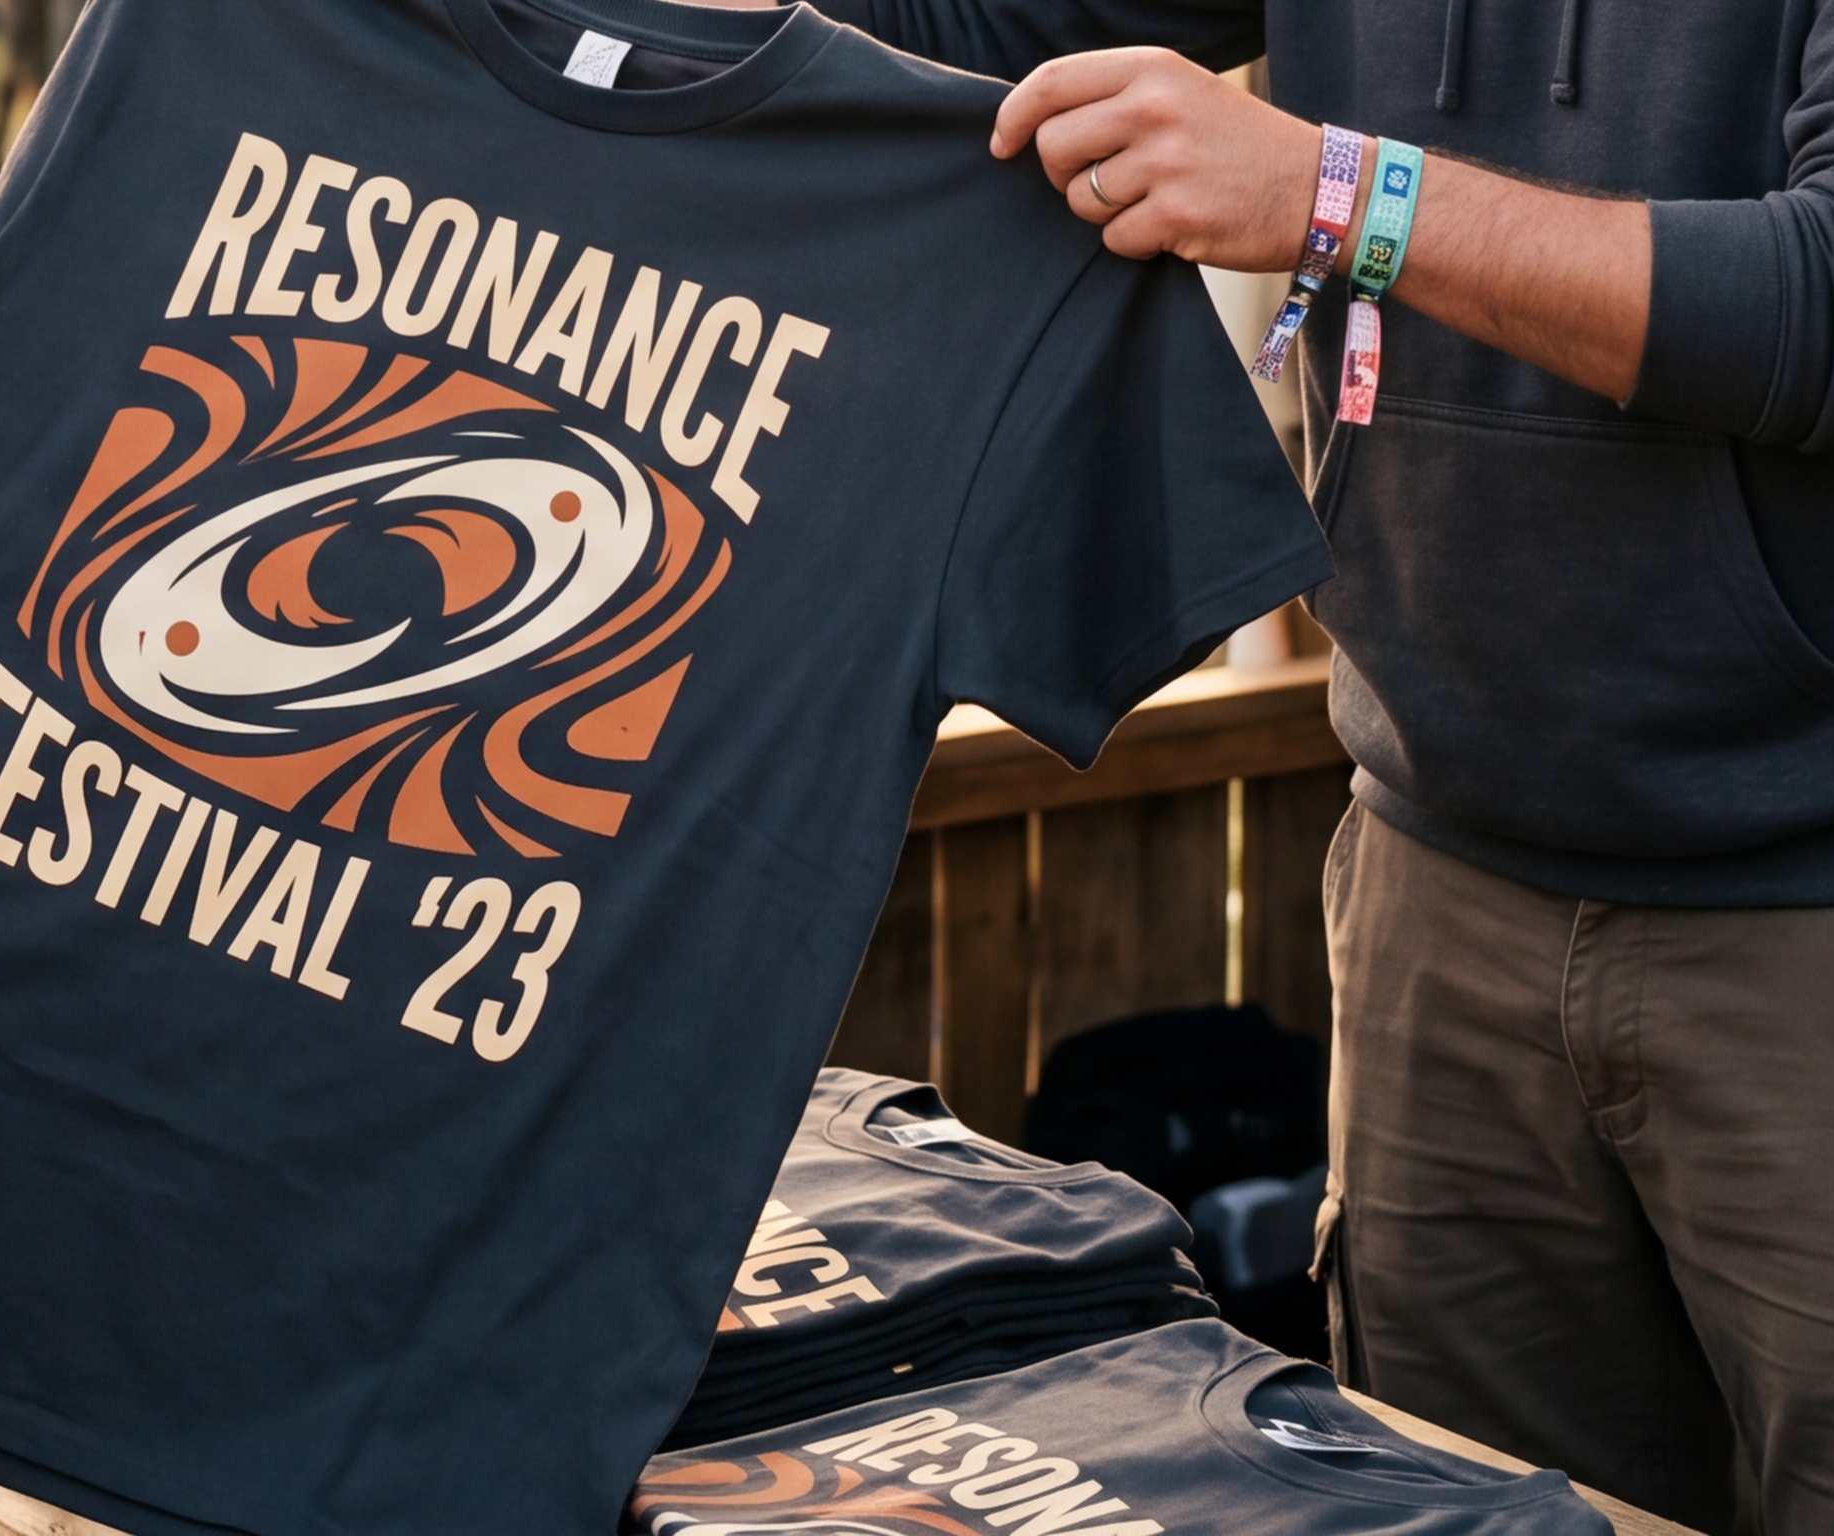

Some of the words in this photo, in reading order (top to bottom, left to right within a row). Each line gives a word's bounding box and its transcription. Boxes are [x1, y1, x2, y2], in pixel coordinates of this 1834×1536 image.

[164, 131, 830, 525] RESONANCE
[399, 874, 582, 1063] '23
[801, 1407, 1165, 1536] RESON
